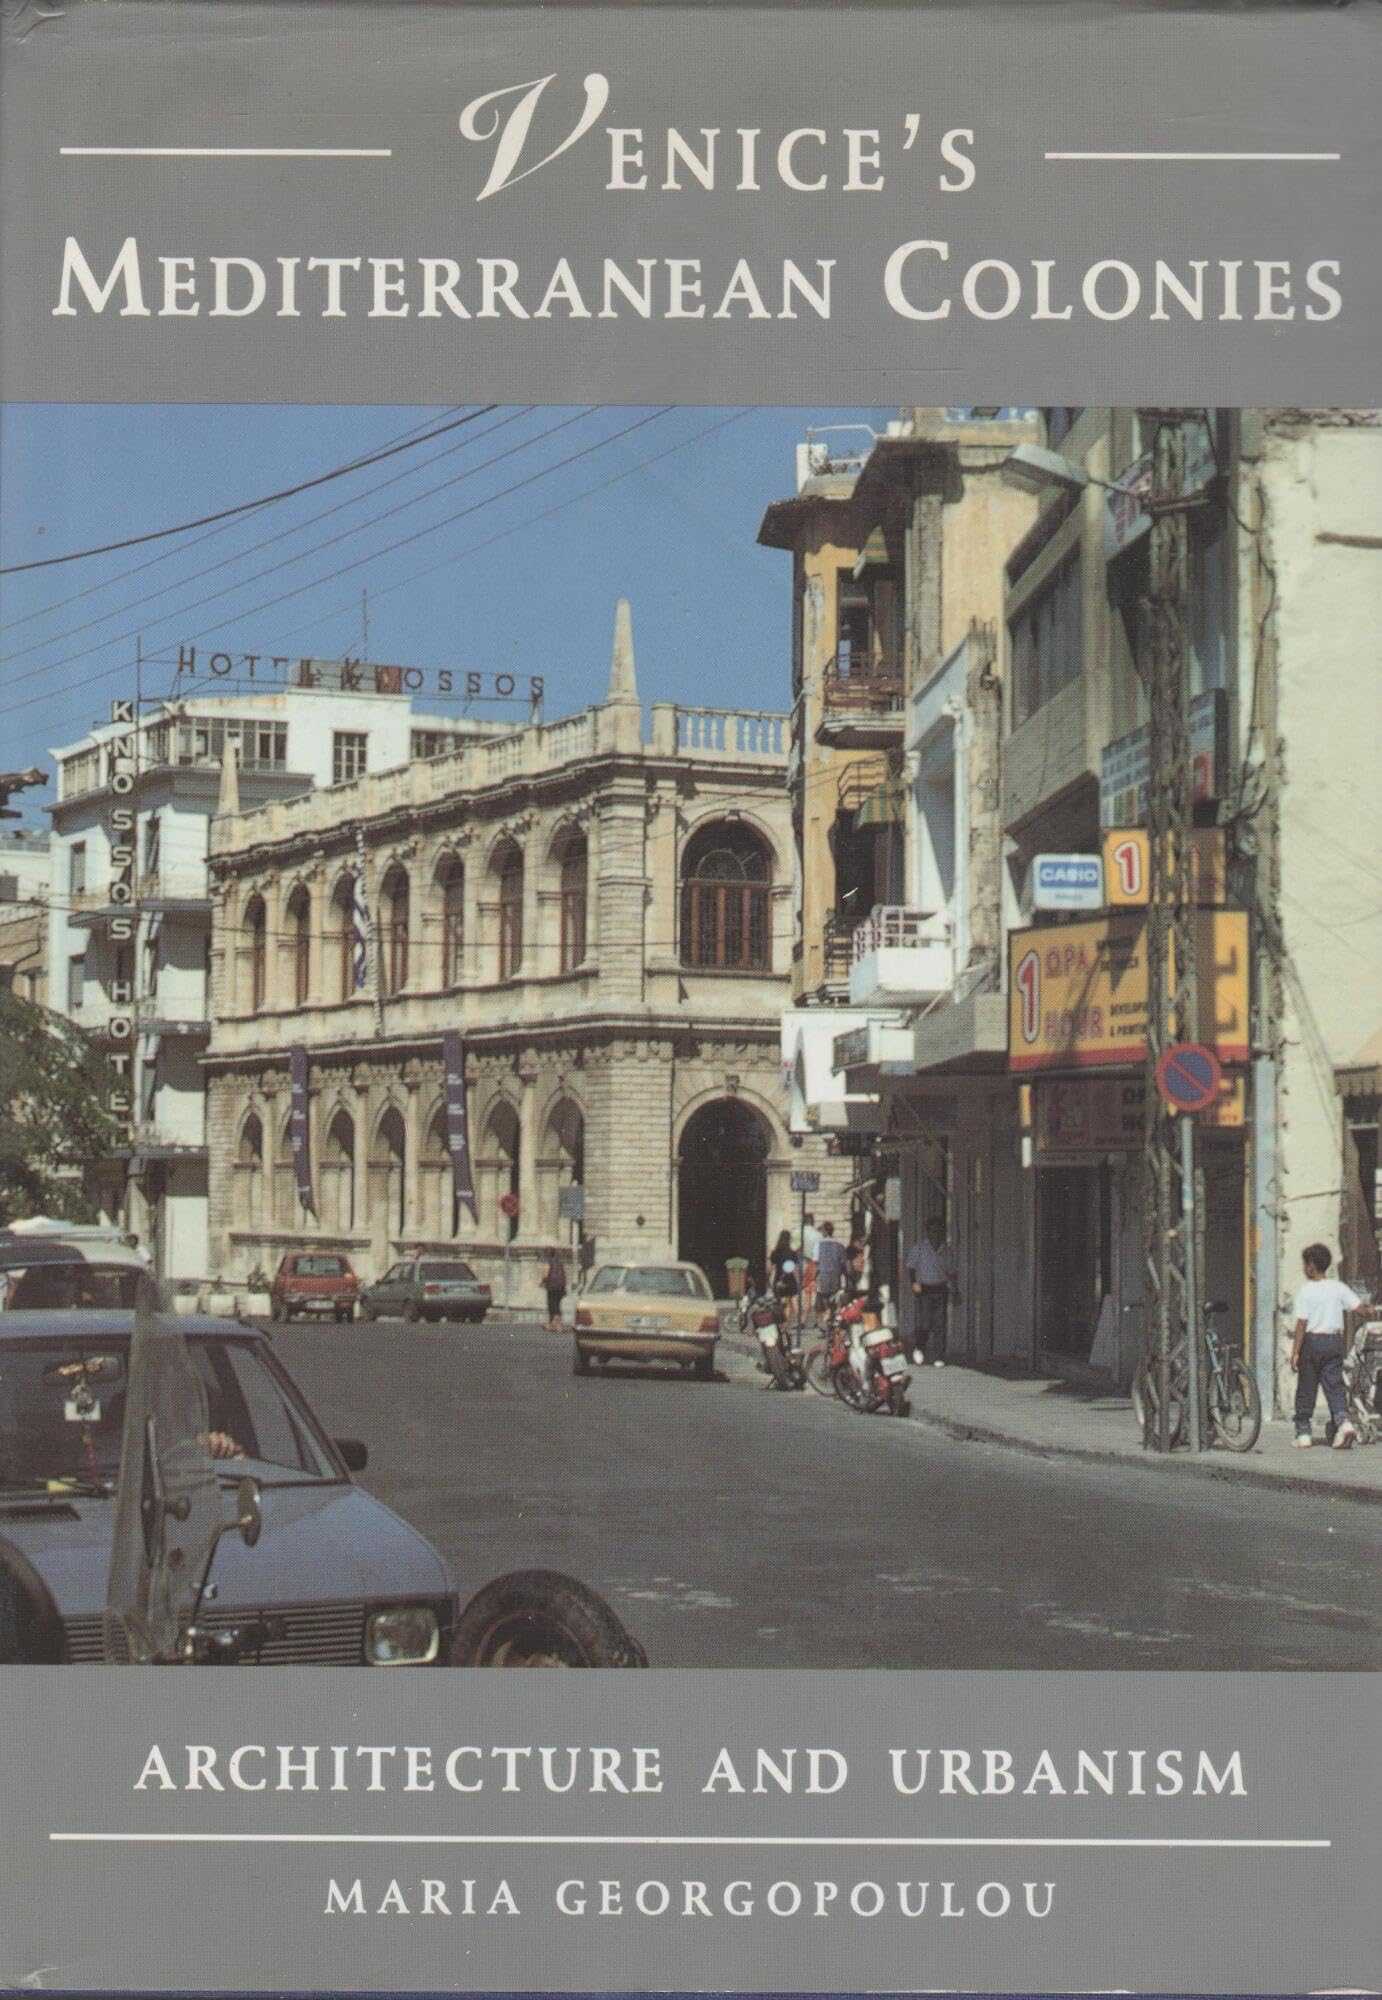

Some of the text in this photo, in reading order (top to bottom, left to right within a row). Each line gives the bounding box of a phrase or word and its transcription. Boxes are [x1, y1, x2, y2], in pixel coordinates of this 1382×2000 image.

[458, 72, 977, 202] VENICE'S
[51, 235, 1343, 322] MEDITERRANEAN COLONIES
[178, 646, 316, 689] HOTL
[1040, 867, 1098, 882] CASIO
[1113, 840, 1141, 896] 1
[110, 701, 134, 1148] KNOSSOS HOTEL
[1016, 947, 1041, 1043] 1
[1110, 1001, 1148, 1017] DEVELOP
[1044, 1006, 1104, 1043] HOUR
[132, 1743, 1249, 1798] ARCHITECTURE AND URBANISM
[323, 1878, 1057, 1920] MARIA GEORGOPOULOU
